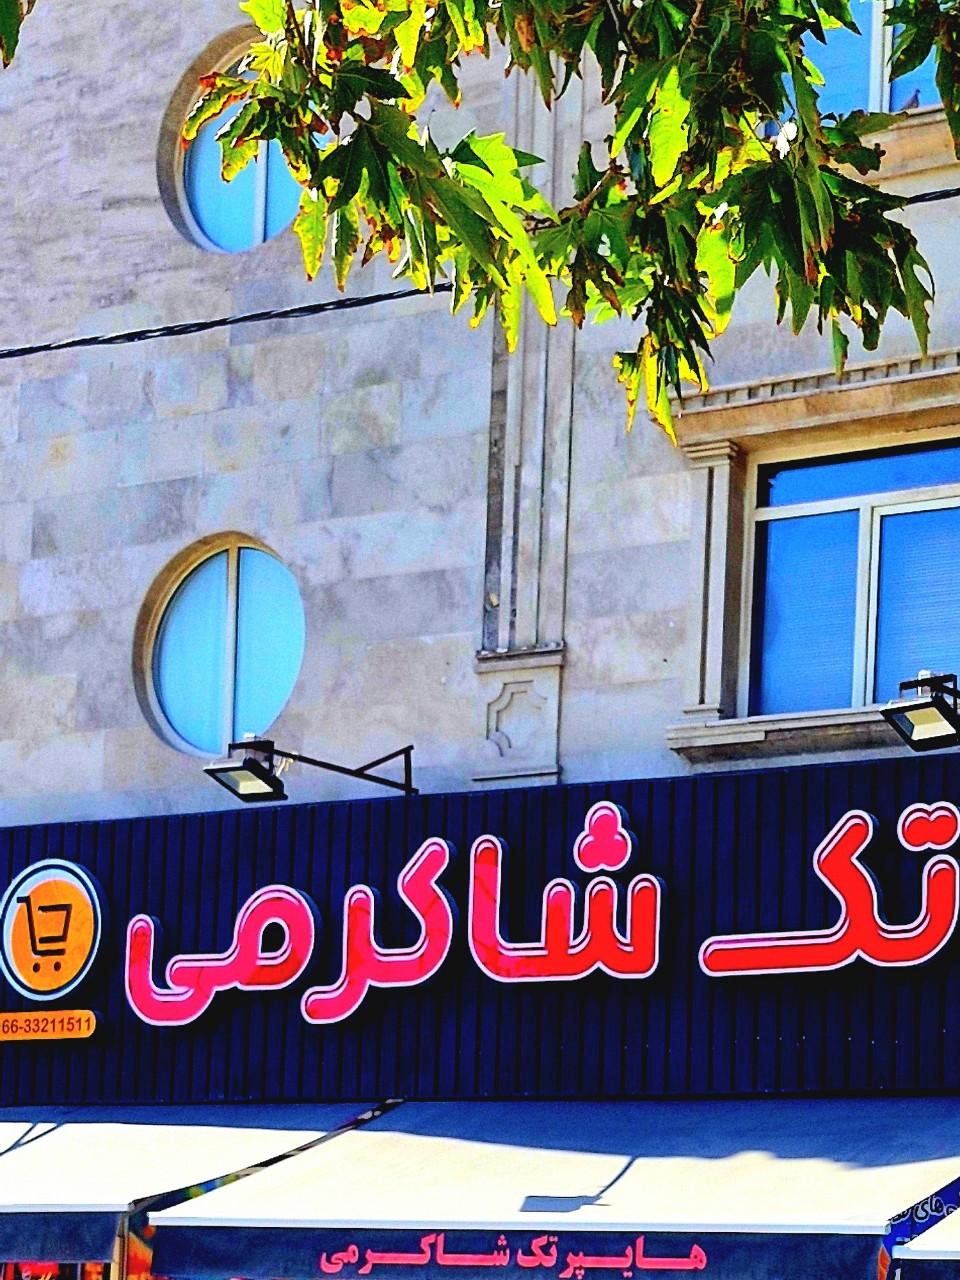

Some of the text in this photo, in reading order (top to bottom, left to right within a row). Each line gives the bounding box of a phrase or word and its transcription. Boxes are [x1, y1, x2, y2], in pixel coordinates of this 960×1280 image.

[126, 801, 661, 1026] شاکرمی
[0, 1016, 91, 1034] 66-33211511
[320, 1233, 707, 1279] هایپر تک شاکرمی
